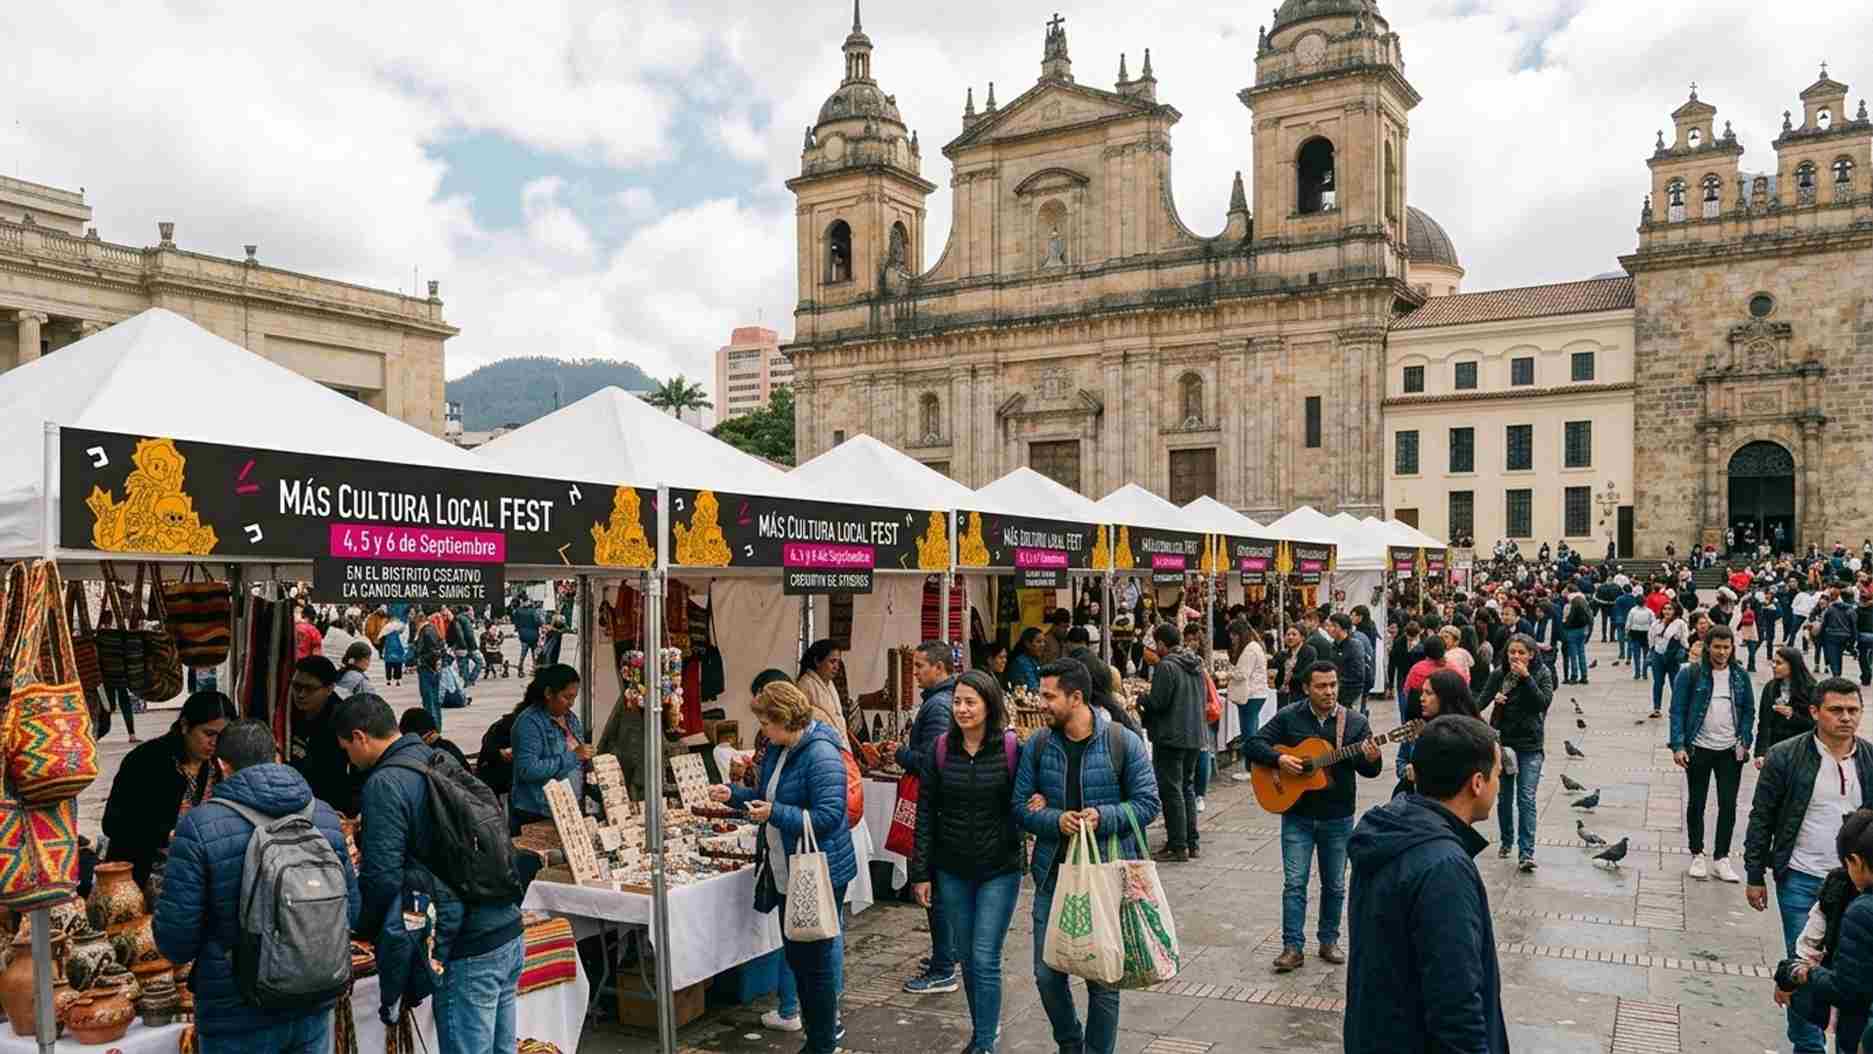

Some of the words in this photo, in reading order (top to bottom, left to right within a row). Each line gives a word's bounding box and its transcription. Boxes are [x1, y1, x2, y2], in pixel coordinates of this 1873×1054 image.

[280, 478, 330, 517] MÁS
[338, 484, 429, 524] CULTURA
[436, 493, 494, 528] LOCAL
[500, 497, 553, 532] FEST
[361, 530, 370, 551] 5
[373, 535, 382, 555] y
[386, 531, 396, 552] 6
[399, 532, 417, 553] de
[420, 534, 497, 557] Septiembre
[759, 510, 785, 538] MÁS
[787, 515, 836, 541] CULTURA
[838, 521, 869, 543] LOCAL
[871, 521, 899, 546] FEST
[365, 566, 380, 580] EL
